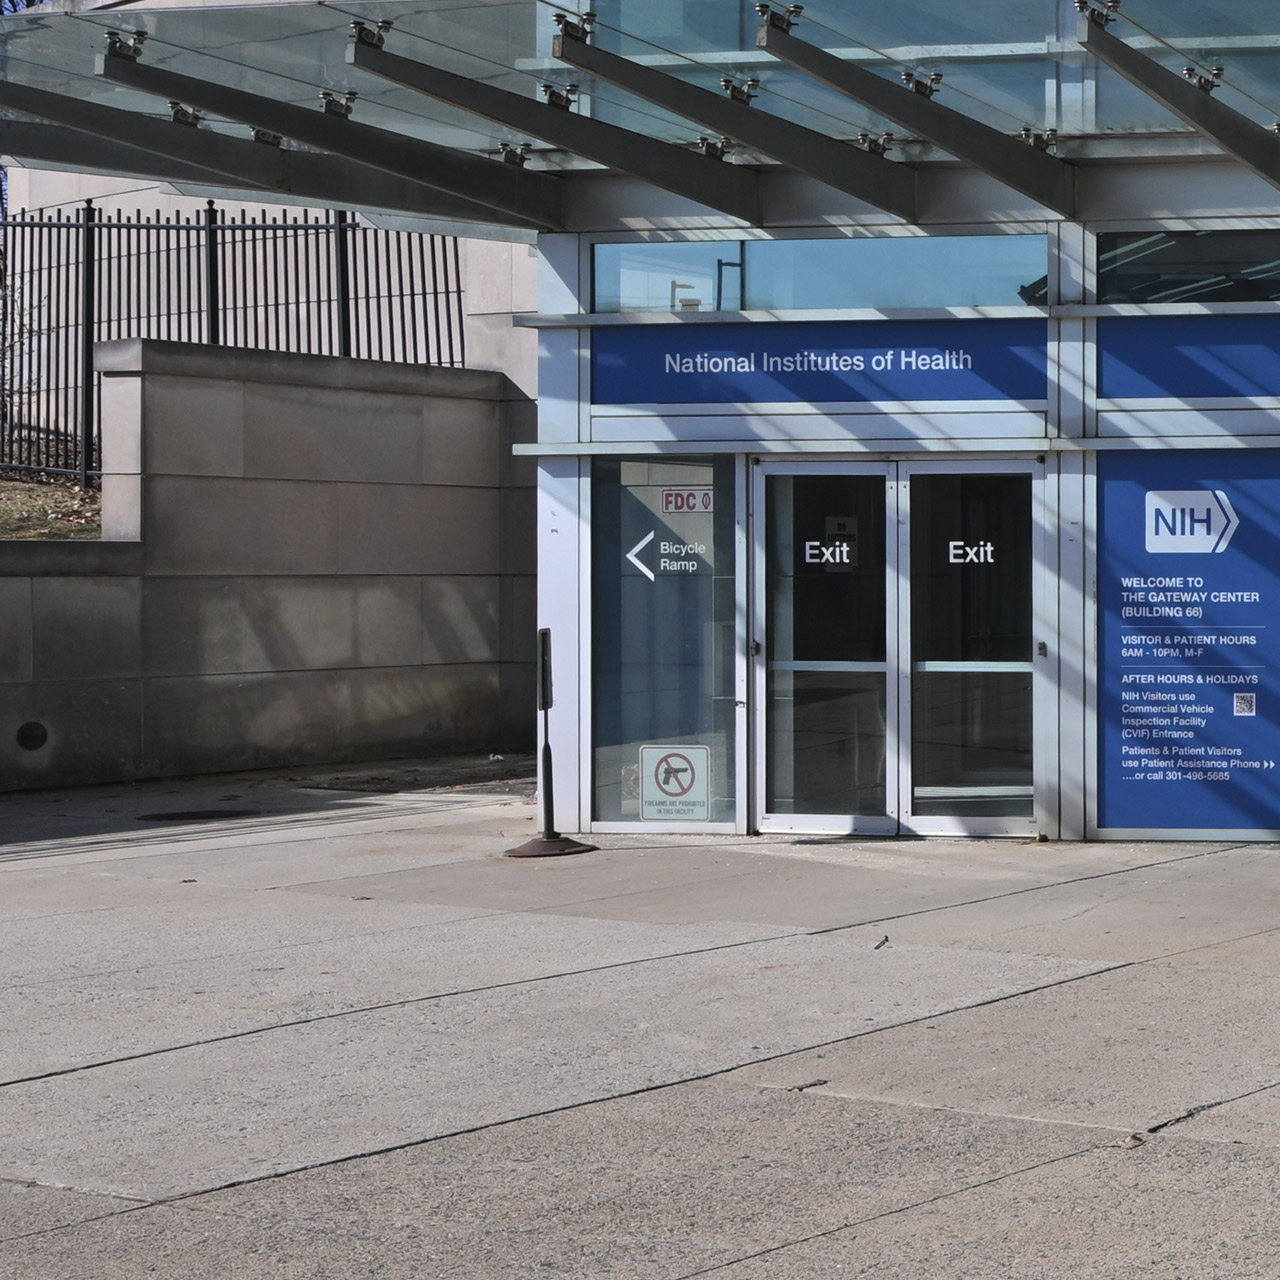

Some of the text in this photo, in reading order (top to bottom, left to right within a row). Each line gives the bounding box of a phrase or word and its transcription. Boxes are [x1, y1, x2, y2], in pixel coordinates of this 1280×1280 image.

[665, 350, 972, 373] National Institutes of Health
[665, 492, 696, 510] FDC
[1154, 507, 1212, 536] NIH
[660, 542, 705, 556] Bicycle
[805, 541, 850, 563] Exit
[949, 541, 994, 563] Exit
[660, 559, 697, 573] Ramp
[1121, 578, 1204, 588] WELCOME TO
[1121, 592, 1260, 602] THE GATEWAY CENTER
[1122, 607, 1203, 619] (BUILDING 66)
[1121, 636, 1256, 644] VISITOR & PATIENT HOURS
[1121, 648, 1143, 657] 6AM
[1153, 648, 1182, 658] 10PM,
[1185, 648, 1204, 657] M-F
[1121, 675, 1258, 684] AFTER HOURS & HOLIDAYS
[1122, 692, 1196, 701] NIH Visitors use
[1122, 704, 1214, 713] Commercial Vehicle
[1122, 717, 1206, 727] Inspection Facility
[1122, 729, 1194, 739] (CVIF) Entrance
[1122, 746, 1242, 756] Patients & Patient Visitors
[1122, 759, 1261, 769] use Patient Assistance Phone
[1147, 772, 1163, 780] call
[1166, 772, 1230, 780] 301-496-5685
